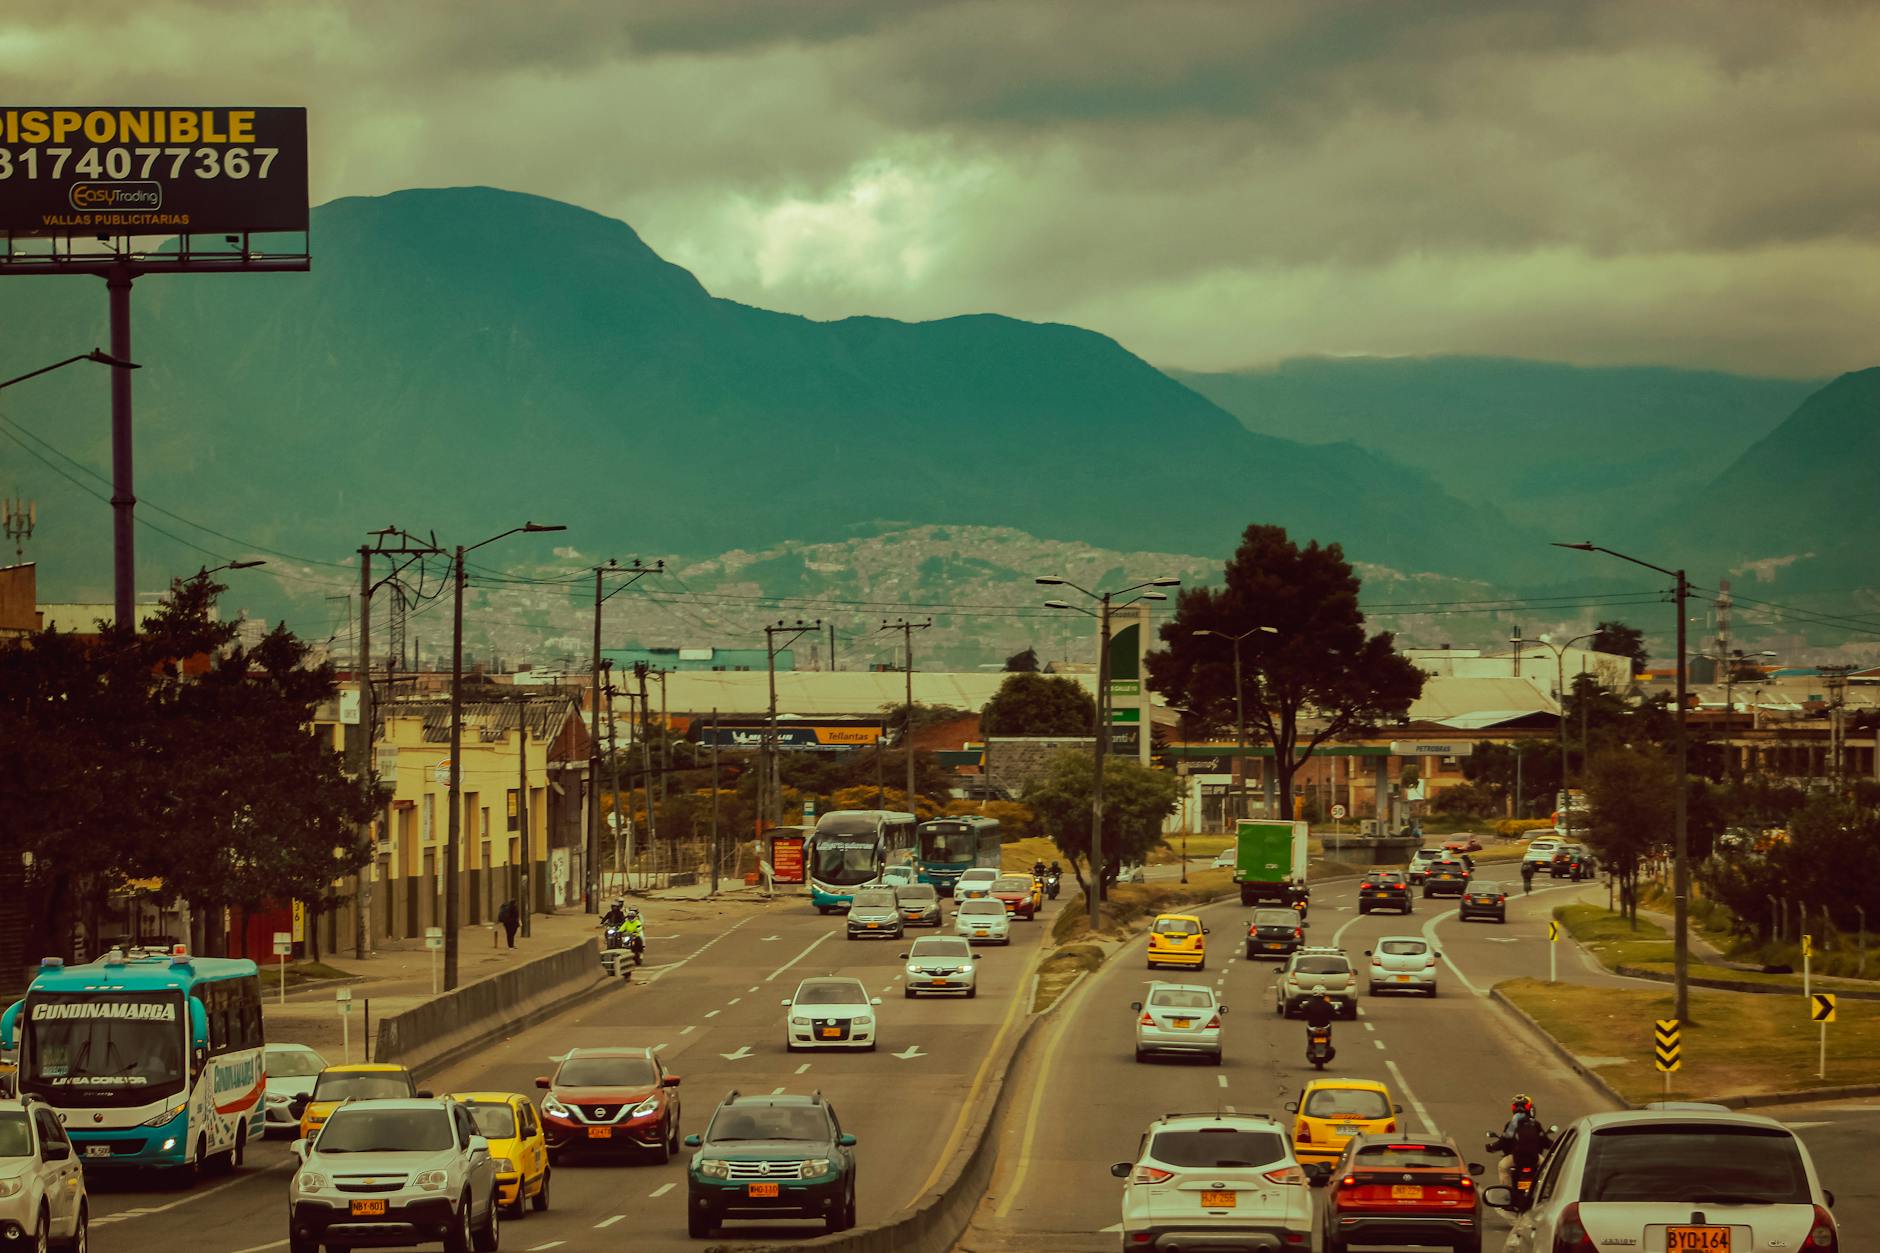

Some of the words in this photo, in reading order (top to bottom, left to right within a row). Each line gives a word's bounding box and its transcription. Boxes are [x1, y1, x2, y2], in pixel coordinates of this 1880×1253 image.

[0, 111, 256, 143] ISPONIBLE
[42, 215, 91, 225] VALLAS
[95, 214, 190, 225] PUBLICITARIAS
[828, 732, 869, 740] Tellantas
[1332, 807, 1344, 816] 50
[31, 1003, 176, 1021] CUNDINAMARCA
